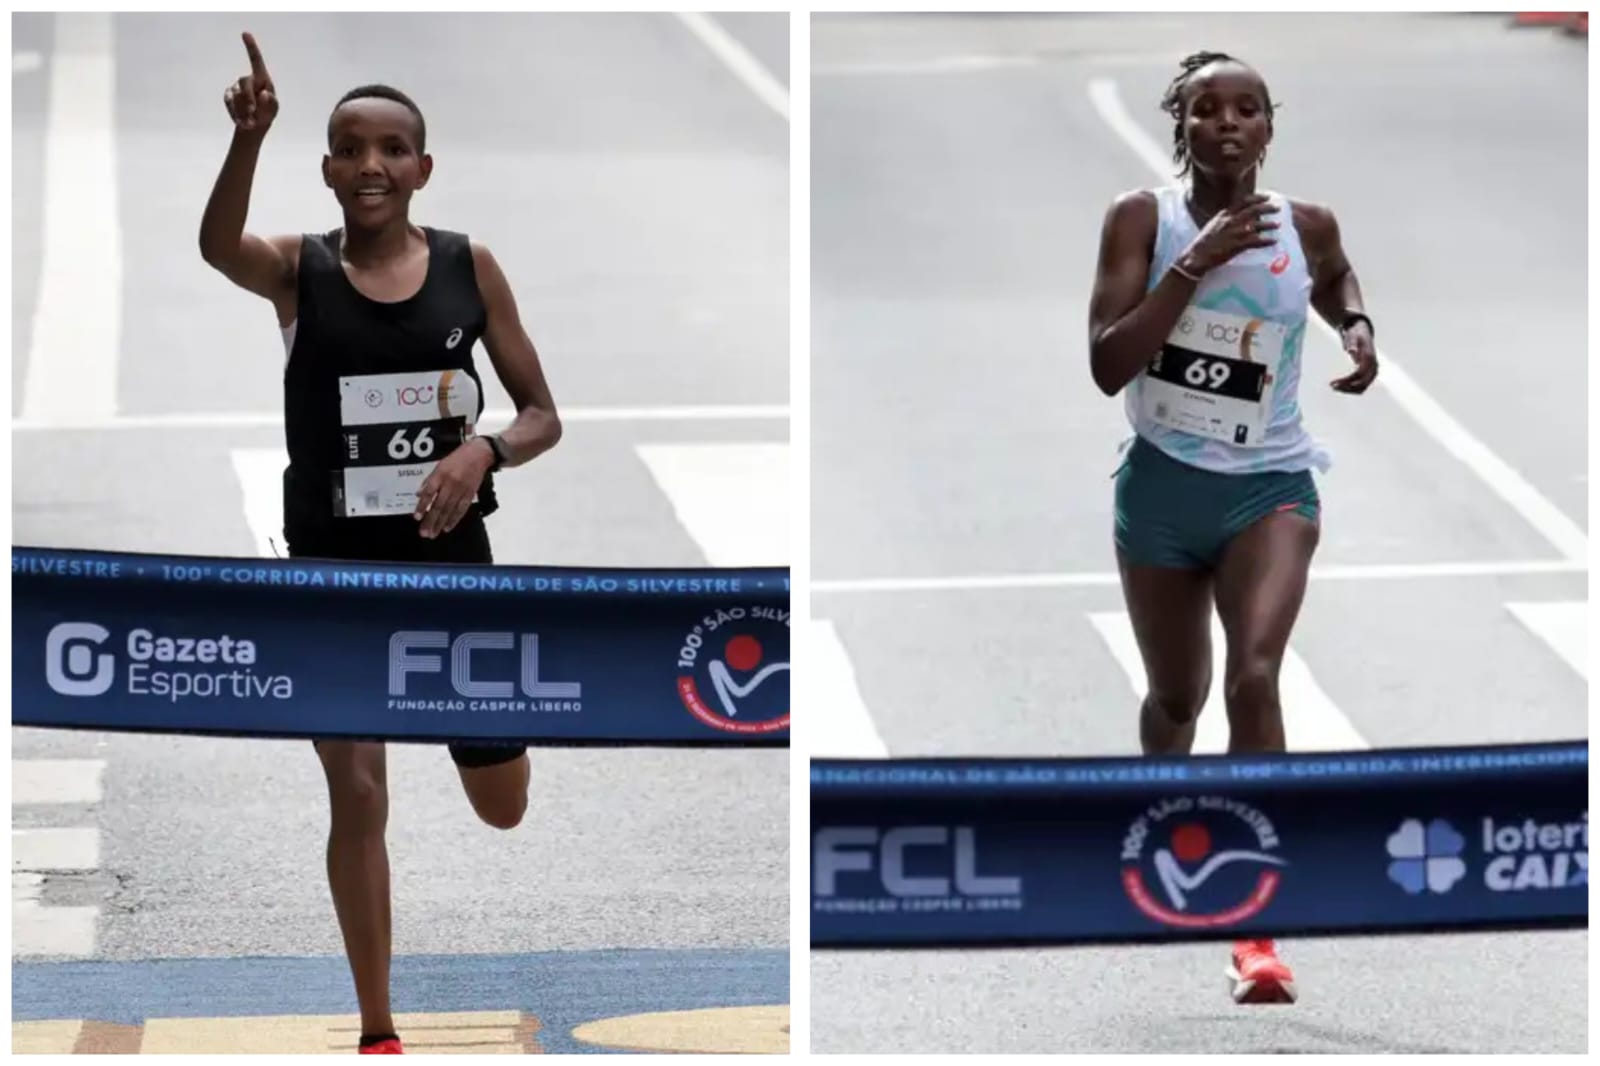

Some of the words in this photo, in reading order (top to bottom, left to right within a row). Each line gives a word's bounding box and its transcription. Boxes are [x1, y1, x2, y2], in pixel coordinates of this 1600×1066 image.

[1185, 358, 1231, 389] 69
[348, 434, 359, 460] ELITE
[387, 427, 434, 460] 66
[219, 567, 325, 587] CORRIDA
[333, 571, 527, 591] INTERNACIONAL
[535, 577, 562, 592] DE
[571, 575, 618, 592] SÃO
[627, 577, 742, 593] SILVESTRE
[703, 608, 746, 632] SÃO
[127, 628, 256, 664] Gazeta
[388, 630, 582, 698] FCL
[128, 663, 293, 702] Esportiva
[388, 699, 466, 712] FUNDAÇÃO
[814, 826, 1022, 897] FCL
